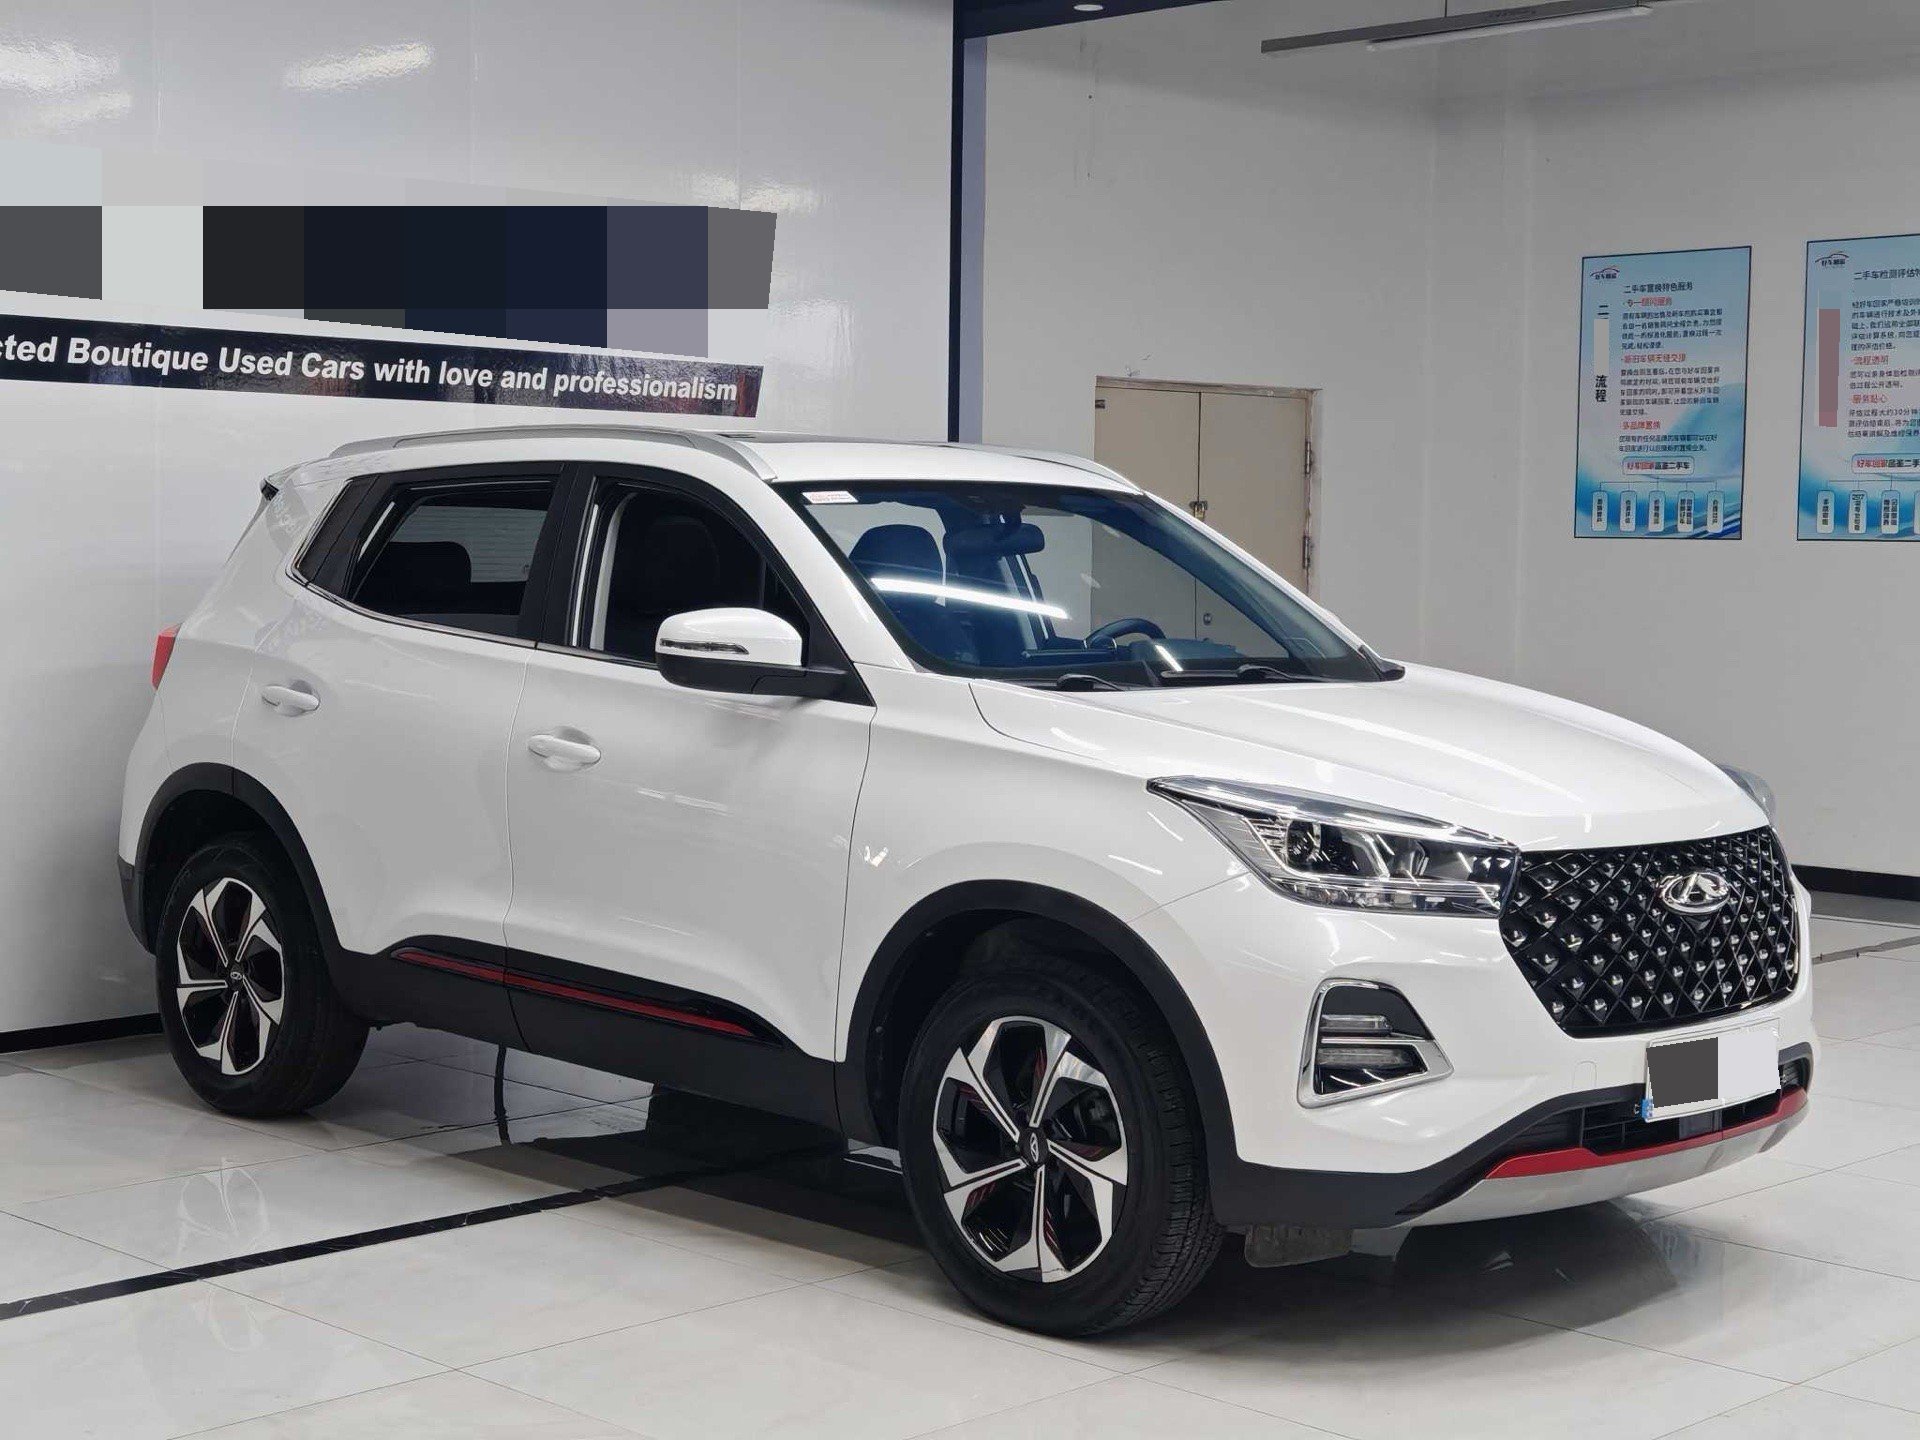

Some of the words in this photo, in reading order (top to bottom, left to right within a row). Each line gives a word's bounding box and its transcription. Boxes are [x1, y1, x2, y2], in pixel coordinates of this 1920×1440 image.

[67, 337, 209, 376] Boutique
[218, 347, 294, 376] Used
[301, 352, 366, 381] Cars
[374, 359, 431, 384] with
[439, 361, 494, 387] love
[500, 367, 549, 391] and
[553, 371, 738, 402] professionalism
